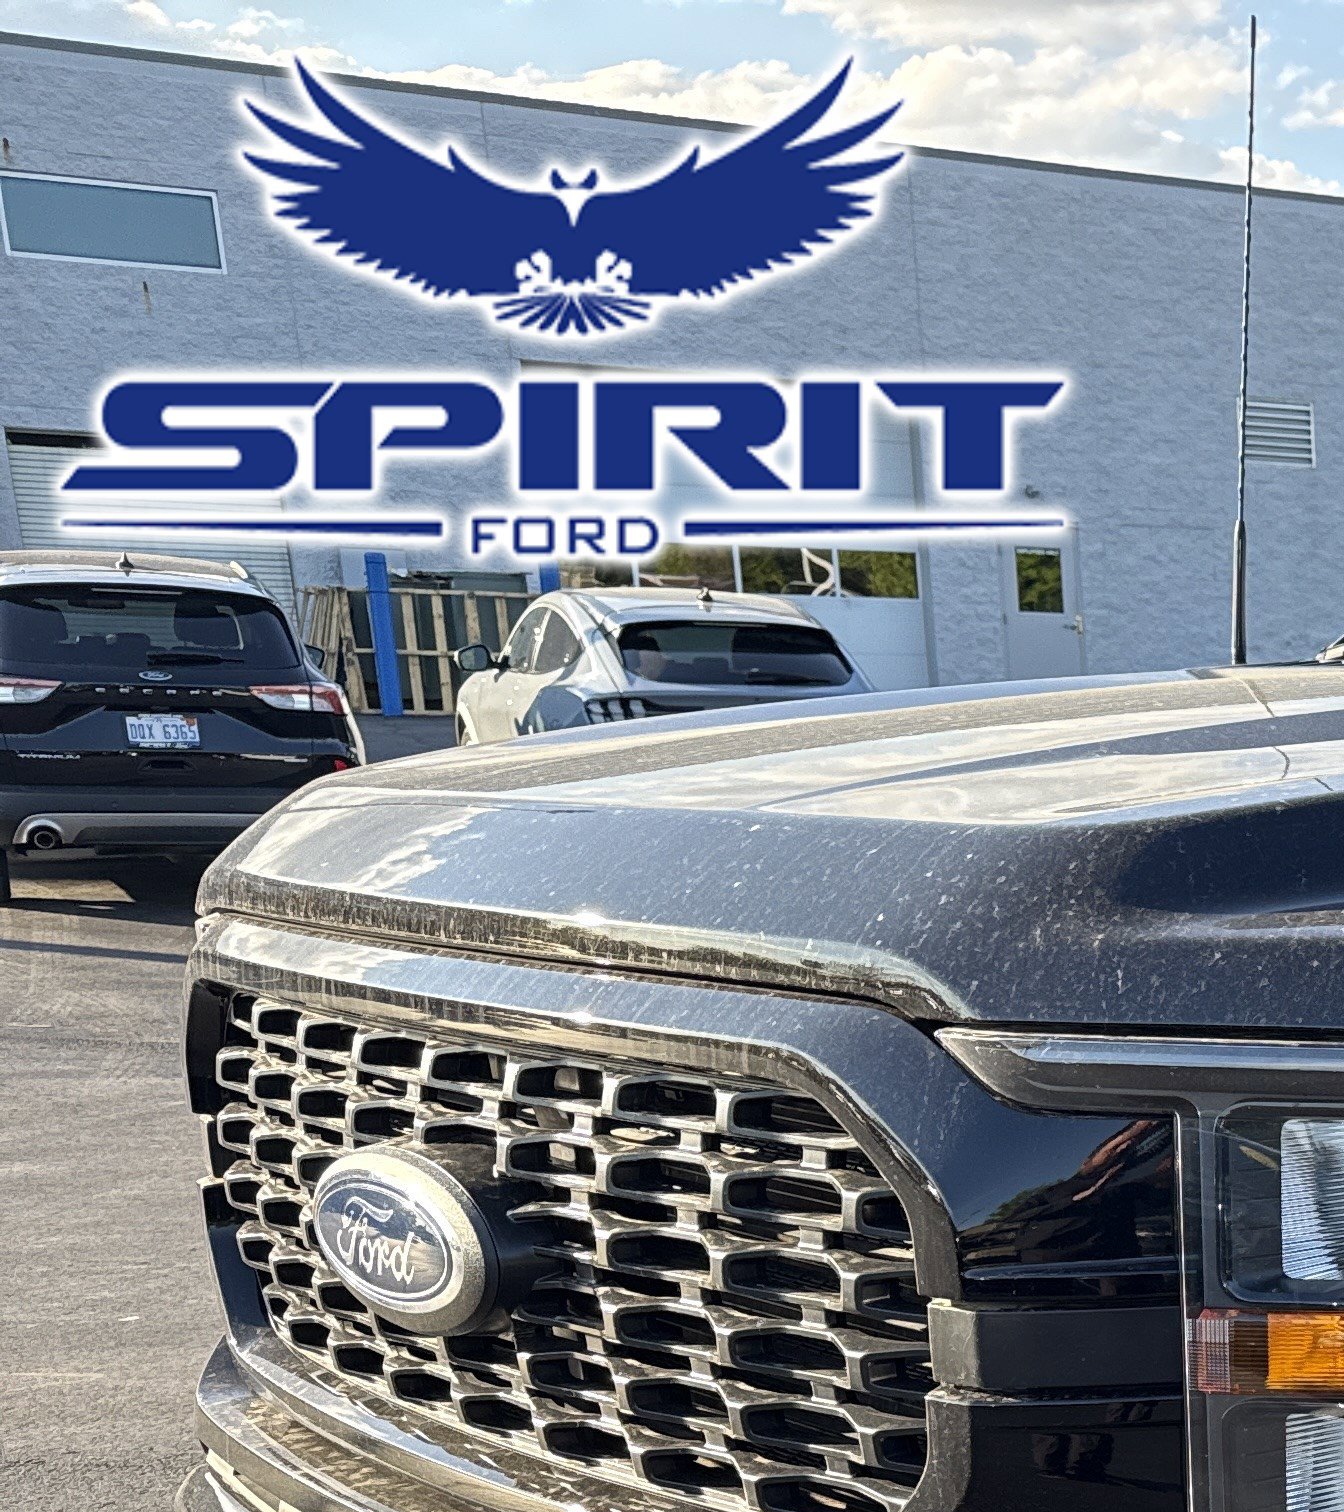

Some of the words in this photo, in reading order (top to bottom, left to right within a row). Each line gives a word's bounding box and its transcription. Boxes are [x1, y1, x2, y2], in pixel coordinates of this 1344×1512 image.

[129, 724, 155, 740] DQX
[162, 724, 197, 740] 6365
[335, 1195, 417, 1286] Ford
